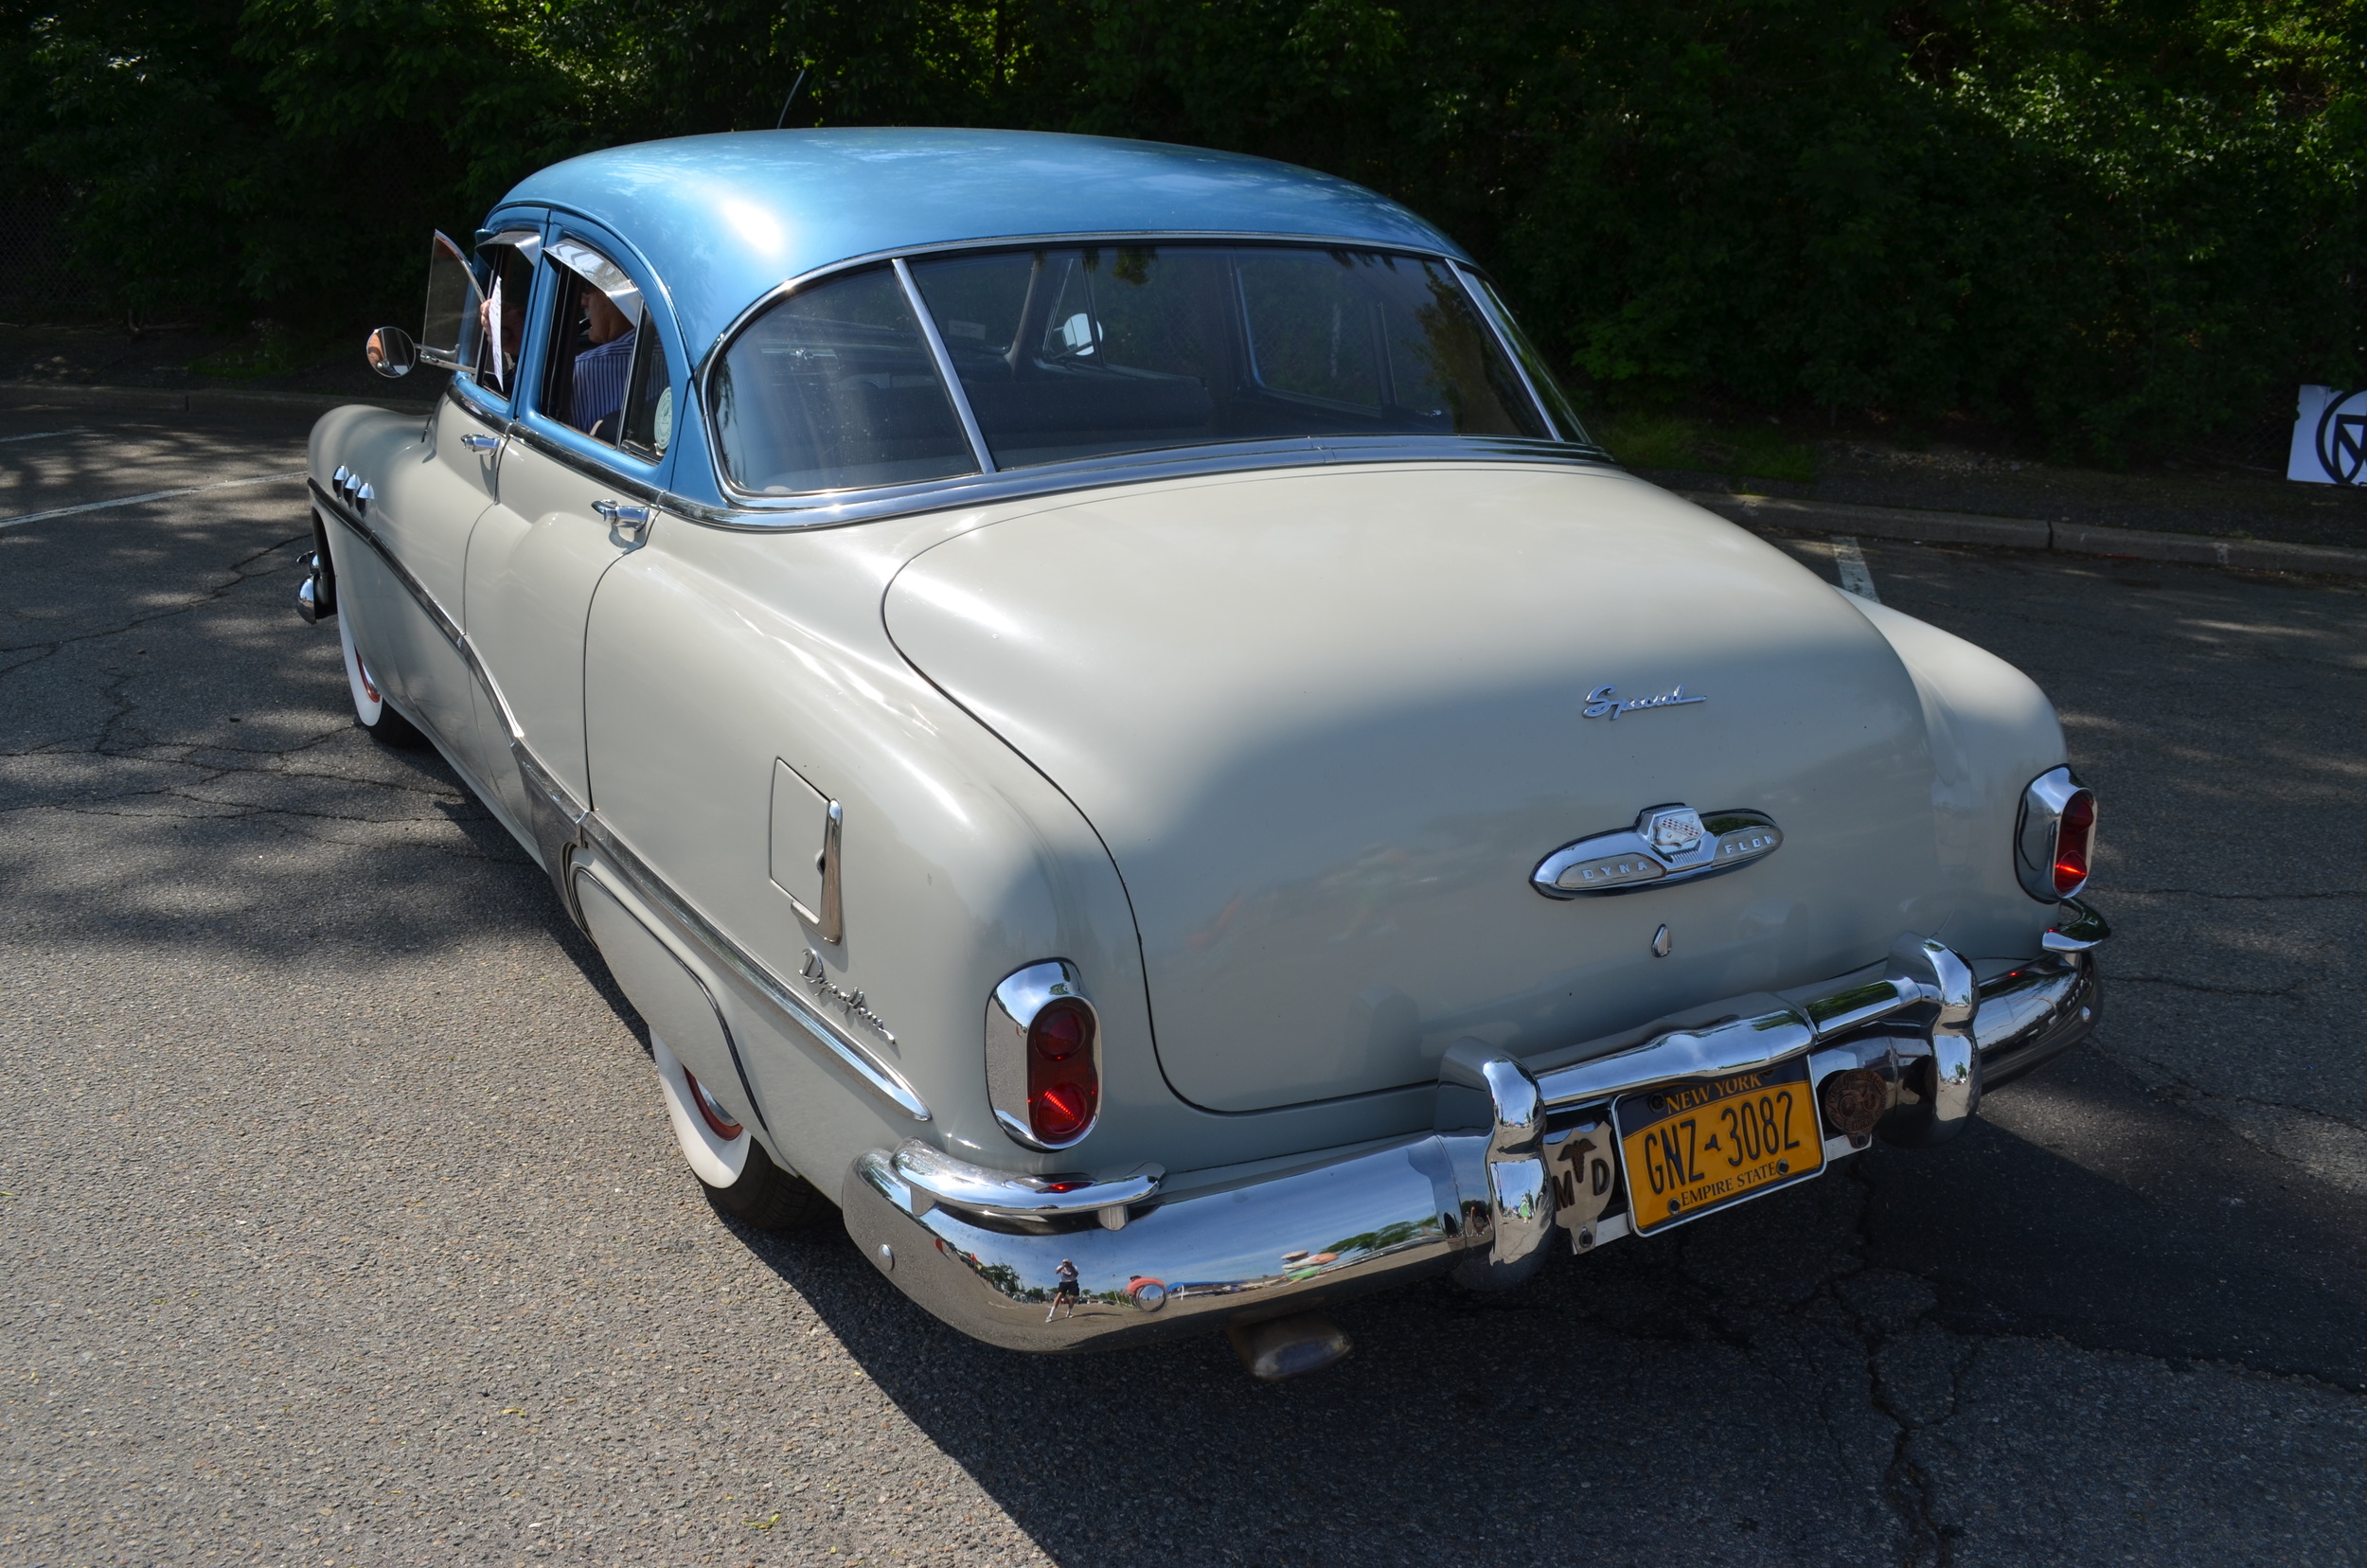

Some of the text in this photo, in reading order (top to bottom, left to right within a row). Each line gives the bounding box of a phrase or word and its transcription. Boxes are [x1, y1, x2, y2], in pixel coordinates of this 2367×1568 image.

[1581, 861, 1648, 879] DYNA
[1666, 1074, 1762, 1114] NEW YORK
[1645, 1090, 1800, 1195] GNZ 3082
[1682, 1162, 1775, 1207] EMPIRE STATE
